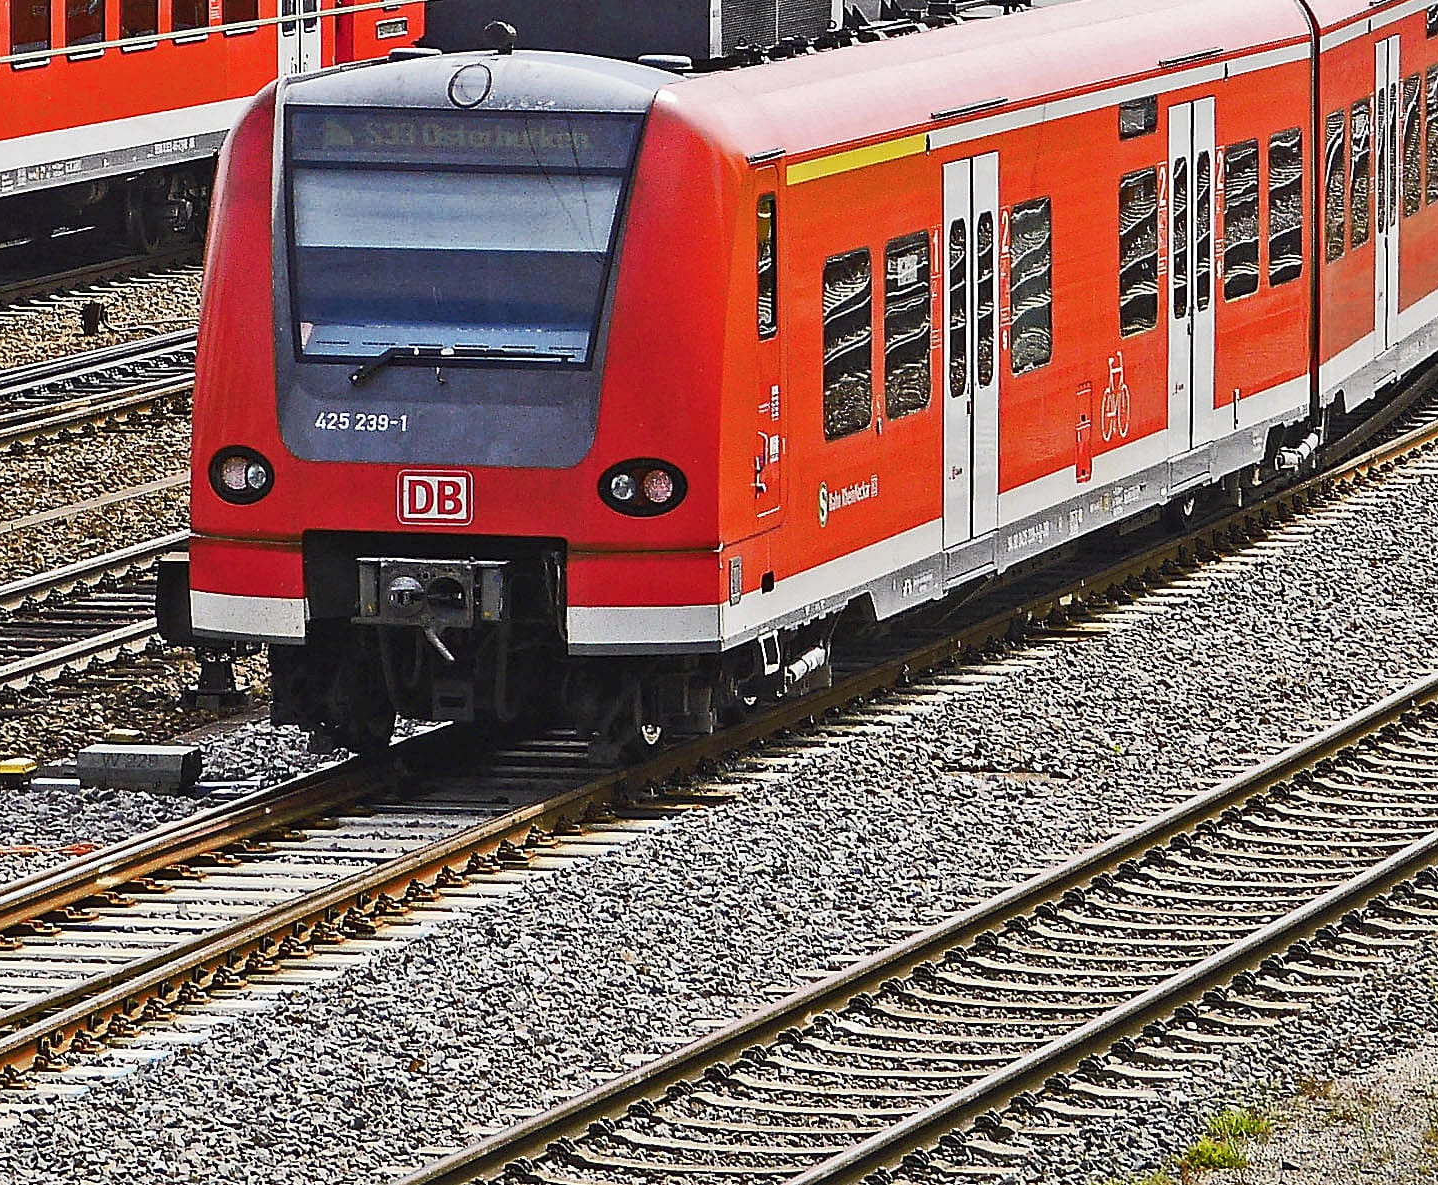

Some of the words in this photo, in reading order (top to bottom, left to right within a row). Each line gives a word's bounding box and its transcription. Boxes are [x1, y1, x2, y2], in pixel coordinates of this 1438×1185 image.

[1158, 167, 1167, 206] 2
[1216, 150, 1224, 190] 2
[932, 229, 940, 273] 1
[1001, 210, 1010, 253] 2
[315, 412, 350, 430] 425
[354, 414, 408, 432] 239-1
[406, 477, 465, 517] DB
[819, 483, 828, 526] S
